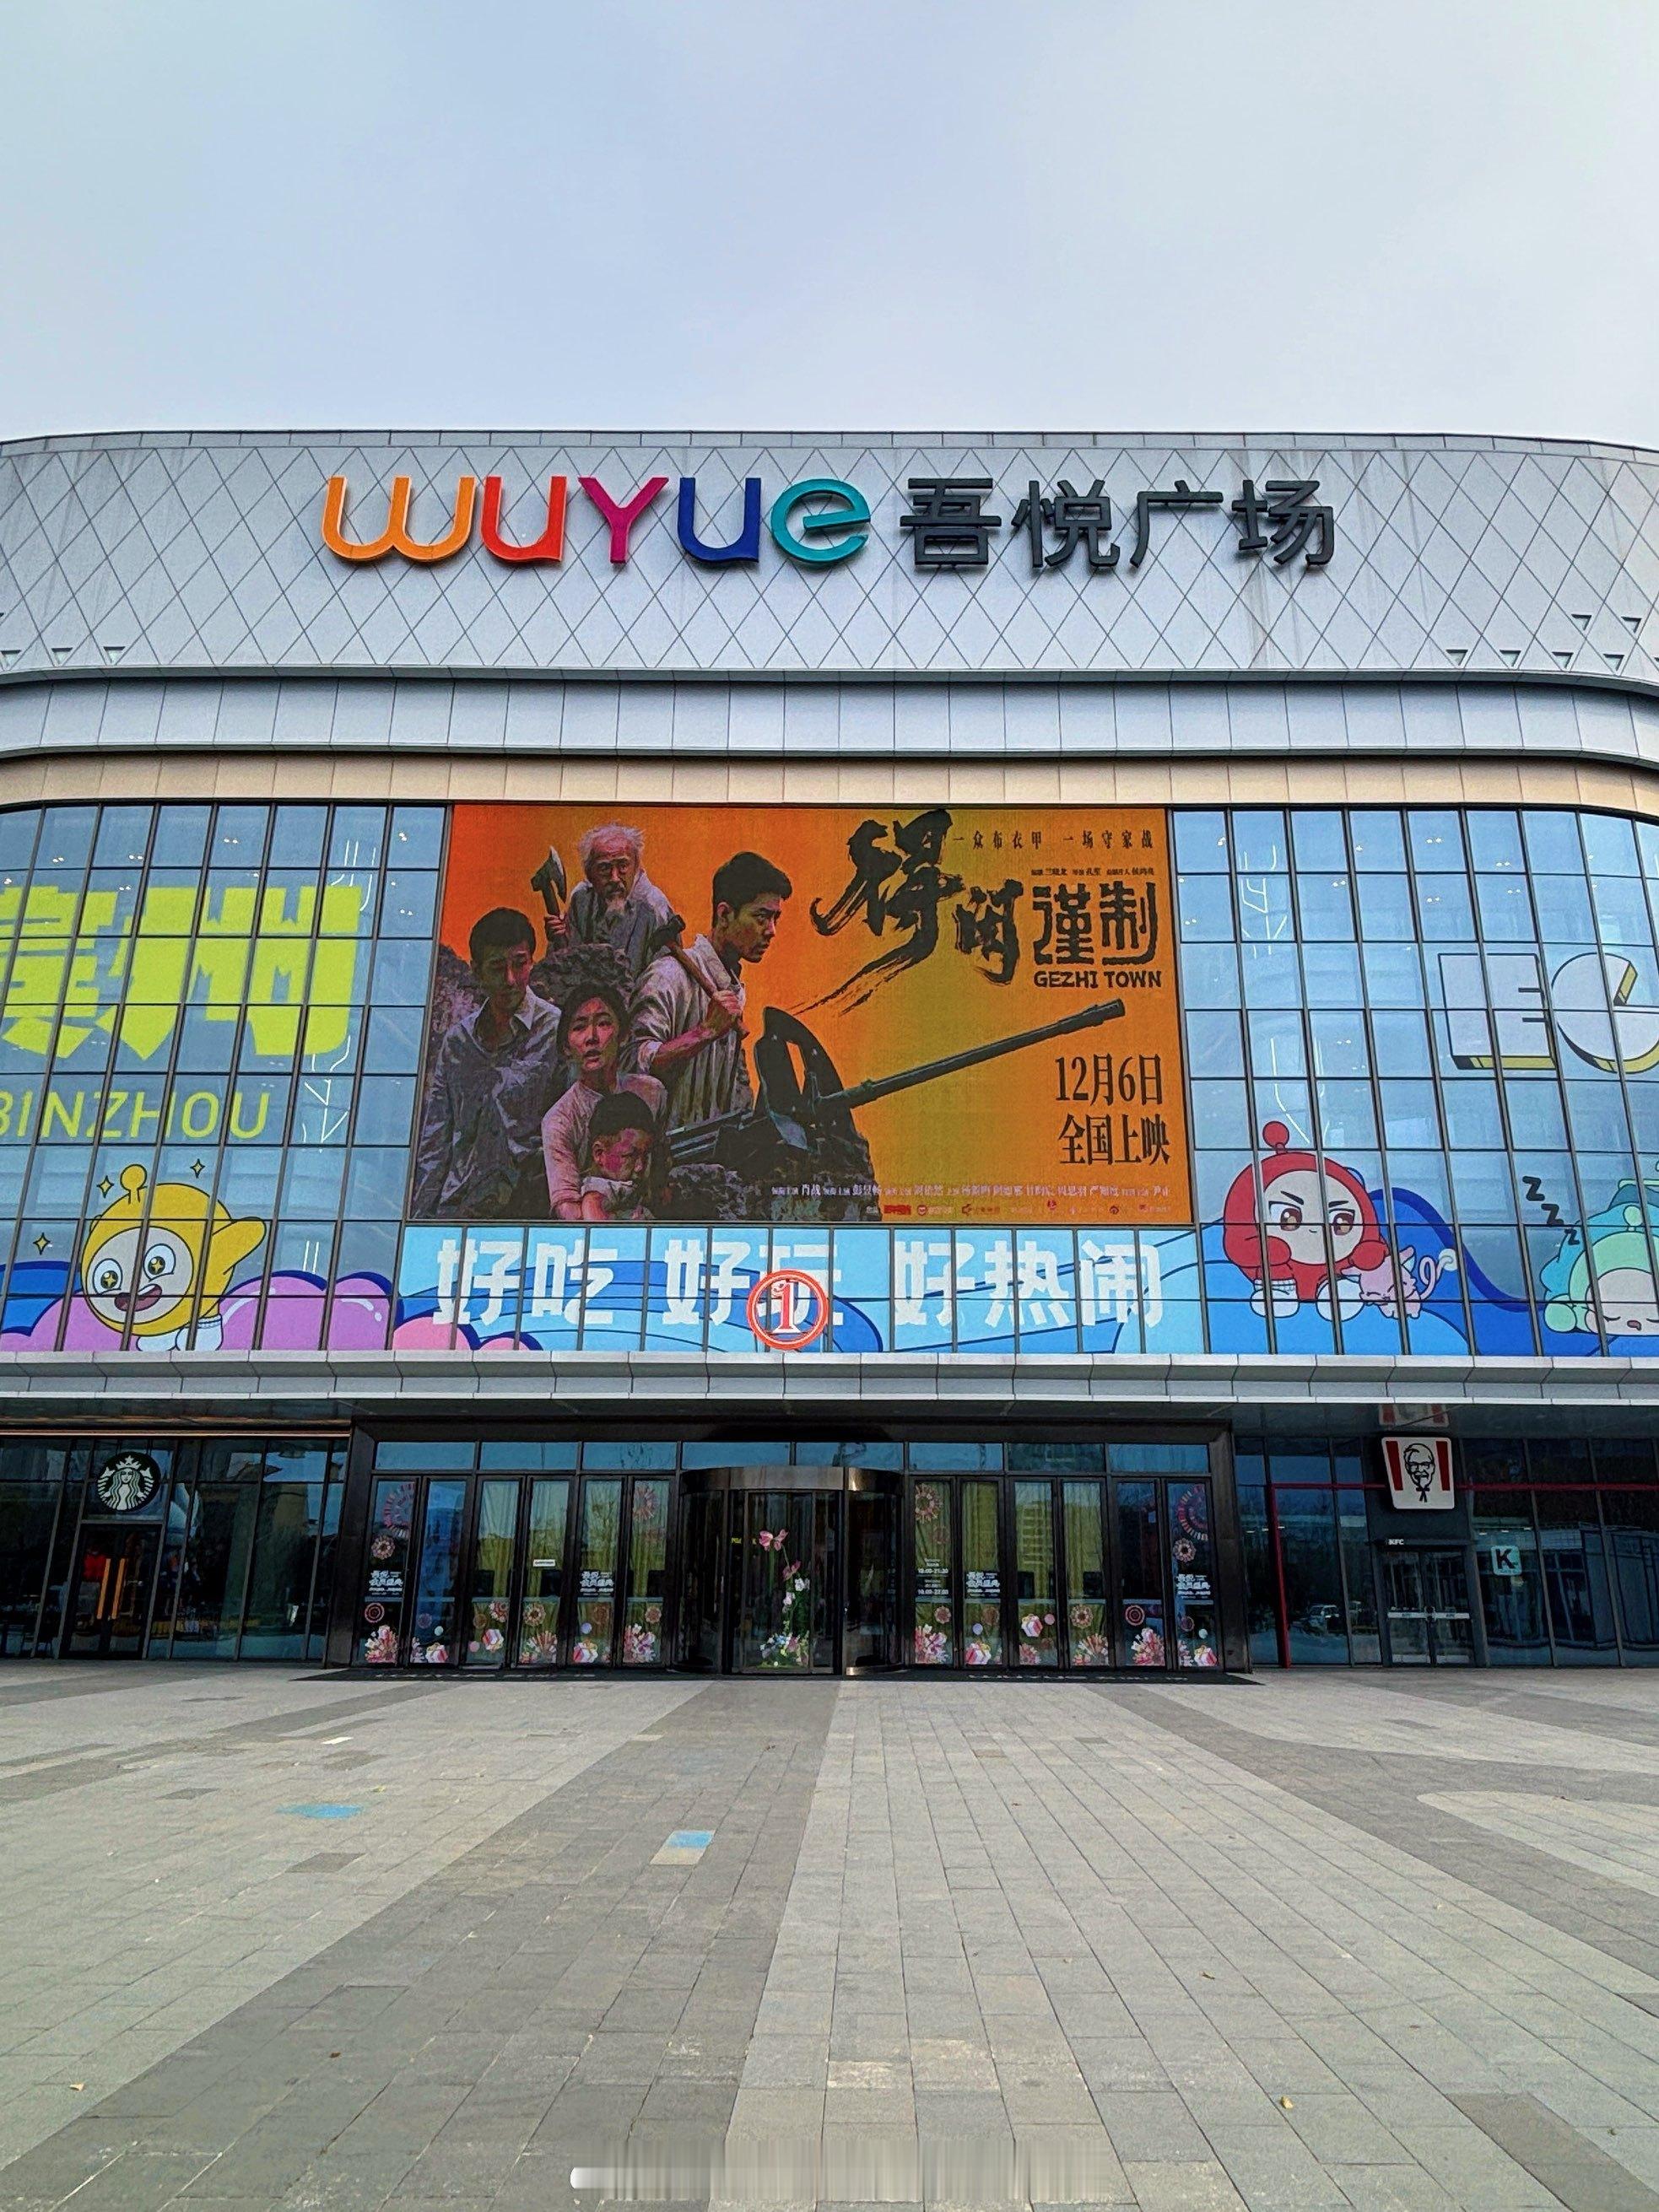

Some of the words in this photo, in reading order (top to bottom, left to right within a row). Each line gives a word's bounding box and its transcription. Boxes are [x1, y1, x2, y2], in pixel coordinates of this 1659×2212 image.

[899, 477, 1333, 571] 吾悦广场
[954, 830, 1042, 850] 一众布衣甲
[1062, 829, 1154, 850] 一场守家战
[1034, 970, 1099, 989] GEZHI
[1107, 970, 1162, 989] TOWN
[1055, 1053, 1165, 1107] 12月6日
[1058, 1114, 1171, 1167] 全国上映
[433, 1238, 618, 1327] 好吃
[662, 1238, 845, 1327] 好玩
[893, 1239, 1163, 1328] 好热闹
